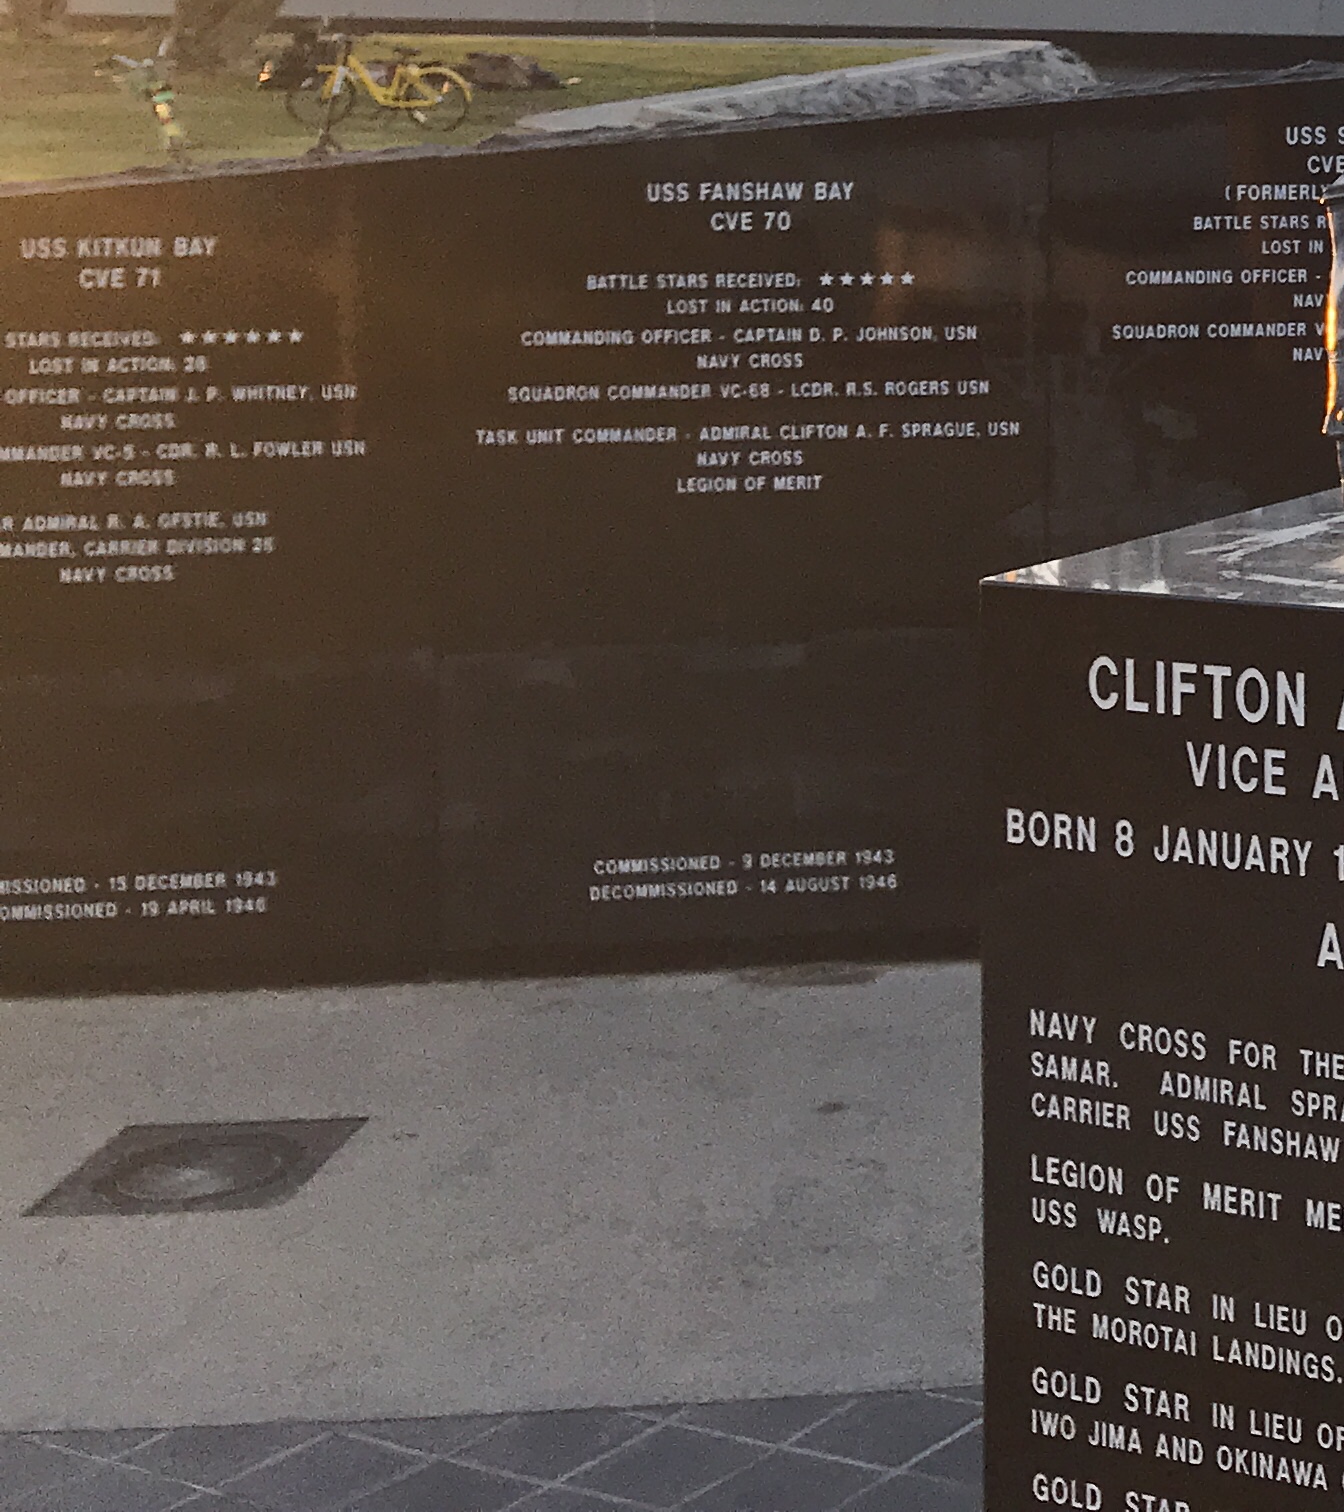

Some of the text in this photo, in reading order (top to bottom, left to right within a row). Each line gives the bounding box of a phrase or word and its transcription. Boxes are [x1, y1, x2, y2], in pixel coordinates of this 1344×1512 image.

[1285, 125, 1327, 146] USS
[647, 181, 854, 202] USS FANSHAW BAY
[710, 210, 791, 231] CVE 70
[19, 237, 67, 260] USS
[173, 236, 217, 258] BAY
[78, 266, 161, 290] CVE 71
[586, 273, 648, 291] BATTLE
[656, 273, 708, 289] STARS
[1125, 268, 1308, 285] COMMANDING OFFICER
[1088, 655, 1306, 727] CLIFTON
[1186, 741, 1287, 796] VICE
[1006, 808, 1096, 853] BORN
[1115, 819, 1135, 858] 8
[1153, 824, 1312, 877] JANUARY
[1030, 1008, 1097, 1044] NAVY
[1119, 1021, 1207, 1061] CROSS
[1228, 1039, 1277, 1071] FOR
[1032, 1302, 1343, 1384] THE MOROTAI LANDINGS.
